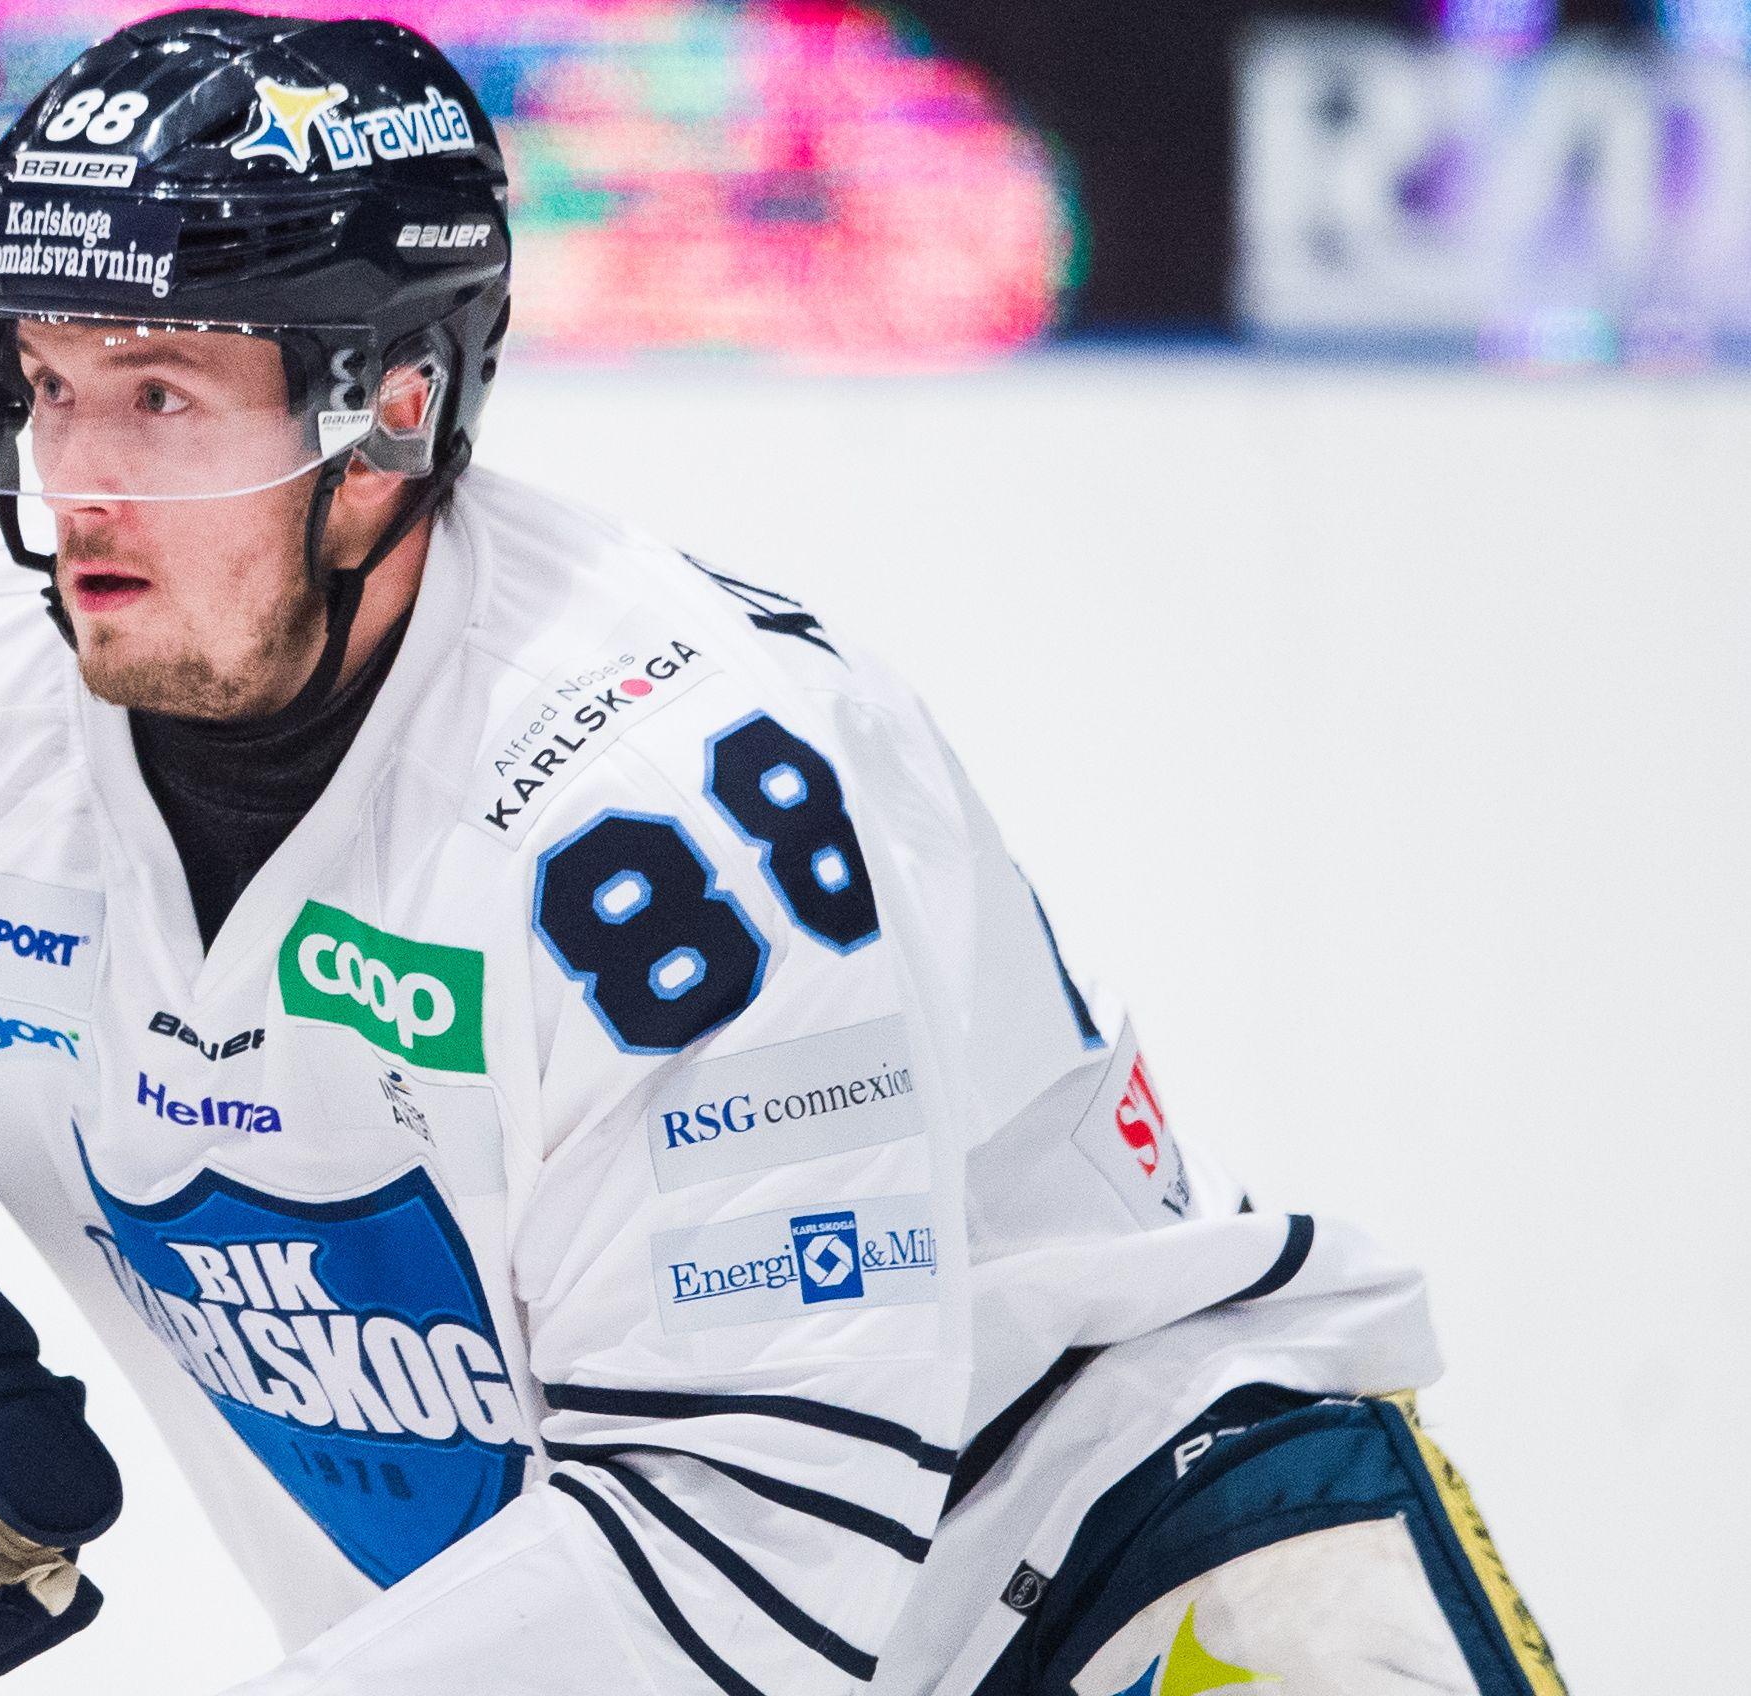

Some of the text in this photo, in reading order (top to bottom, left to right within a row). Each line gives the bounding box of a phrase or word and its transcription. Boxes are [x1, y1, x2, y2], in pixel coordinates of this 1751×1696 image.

[45, 87, 149, 145] 88
[313, 85, 476, 172] bravida
[4, 201, 112, 248] Karlskoga
[484, 640, 702, 832] KARLSKOGA
[494, 702, 558, 777] Alfred
[530, 706, 882, 1057] 88
[298, 933, 456, 1050] coop
[137, 1071, 282, 1134] Helma
[660, 1093, 757, 1150] RSG
[167, 1242, 340, 1311] BIK
[668, 1244, 800, 1298] Energi
